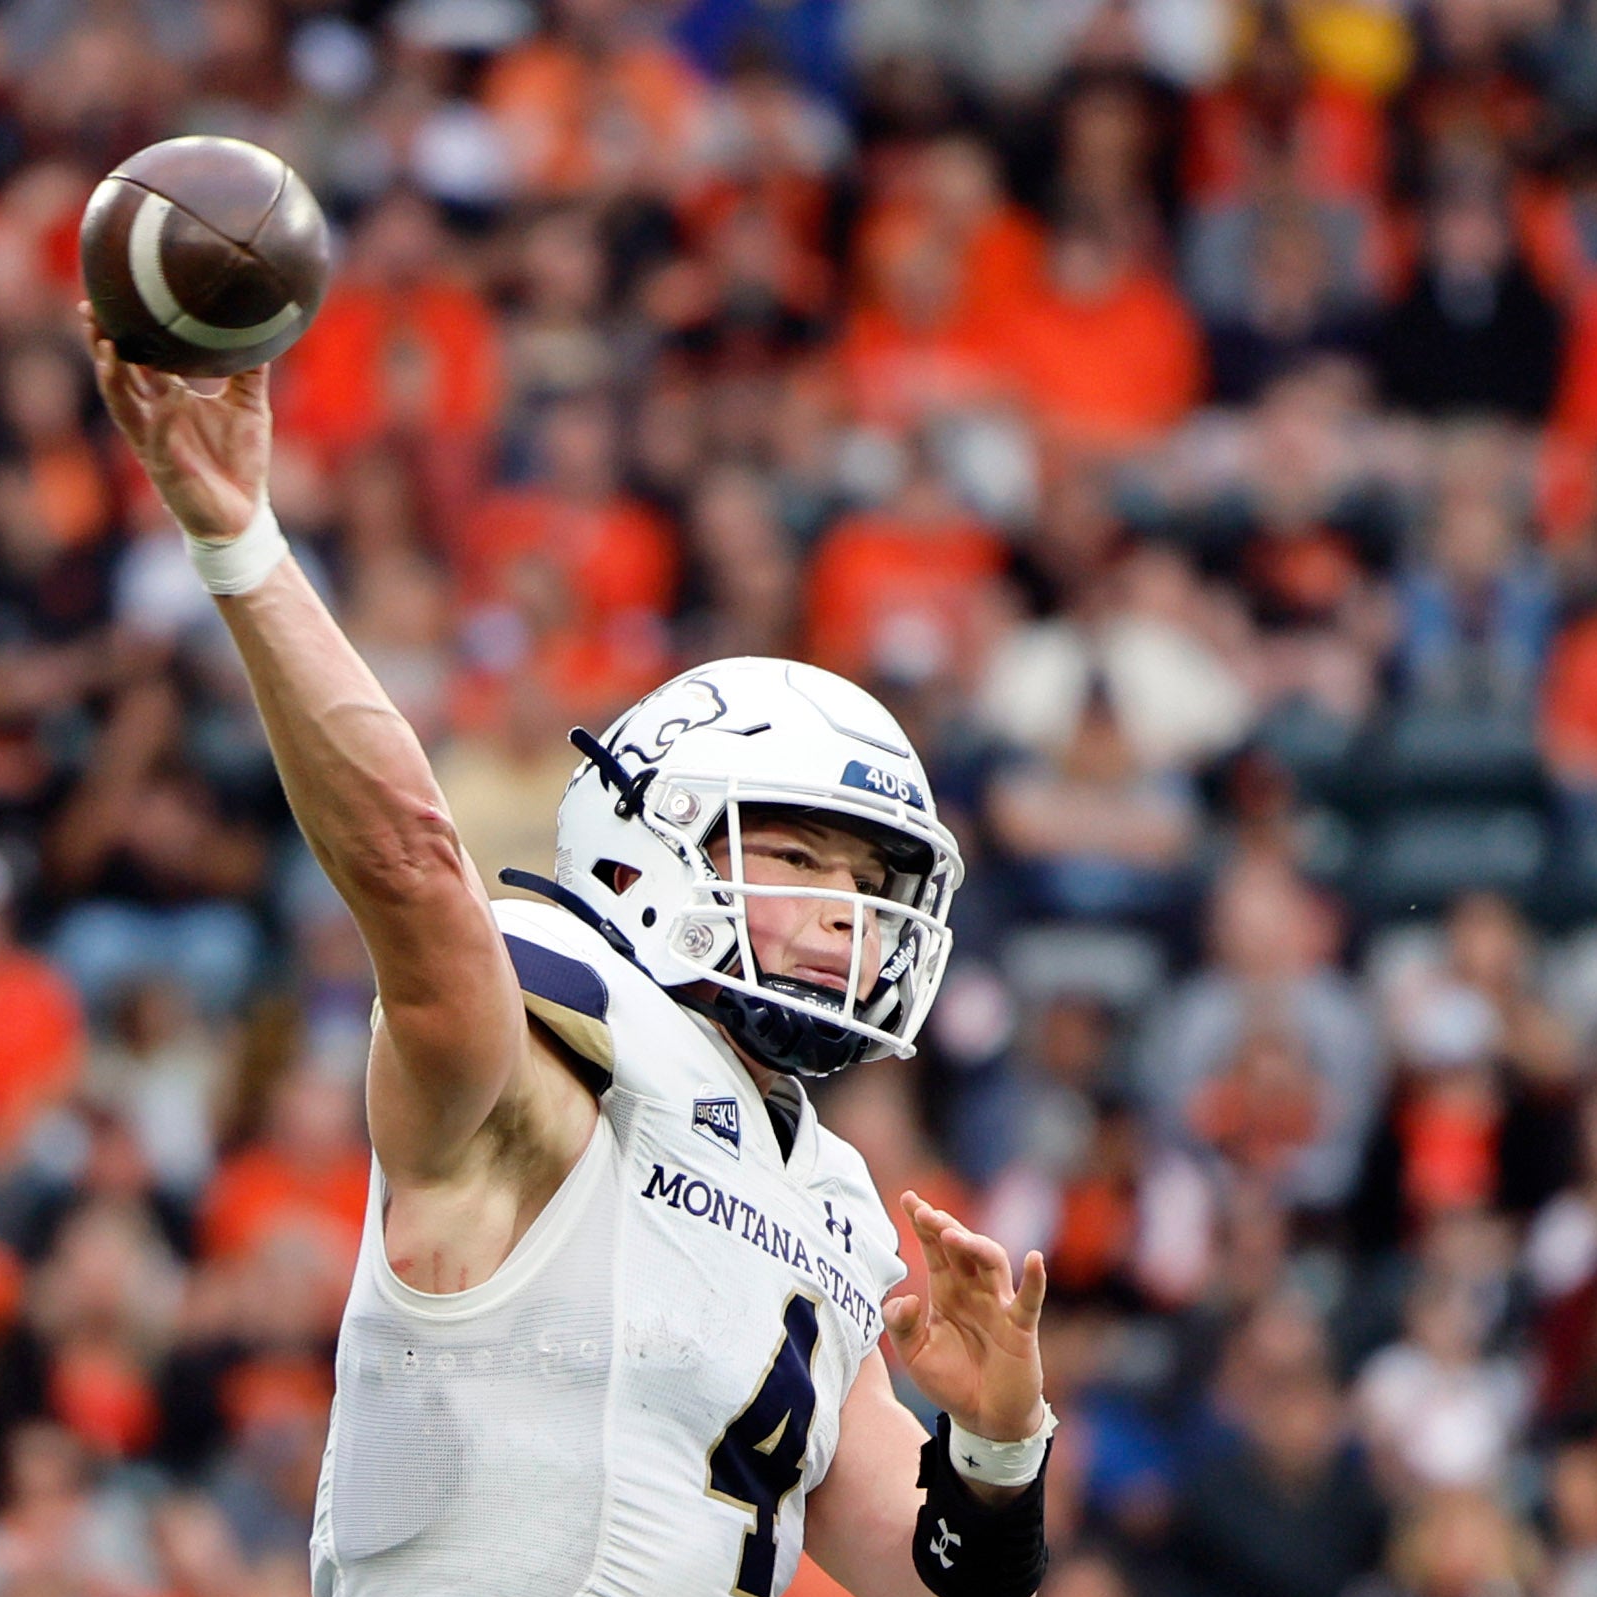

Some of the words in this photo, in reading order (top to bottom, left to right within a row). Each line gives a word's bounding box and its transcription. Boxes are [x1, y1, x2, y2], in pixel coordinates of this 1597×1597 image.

[865, 766, 911, 802] 406
[641, 1163, 814, 1275] MONTANA
[816, 1256, 877, 1342] STATE
